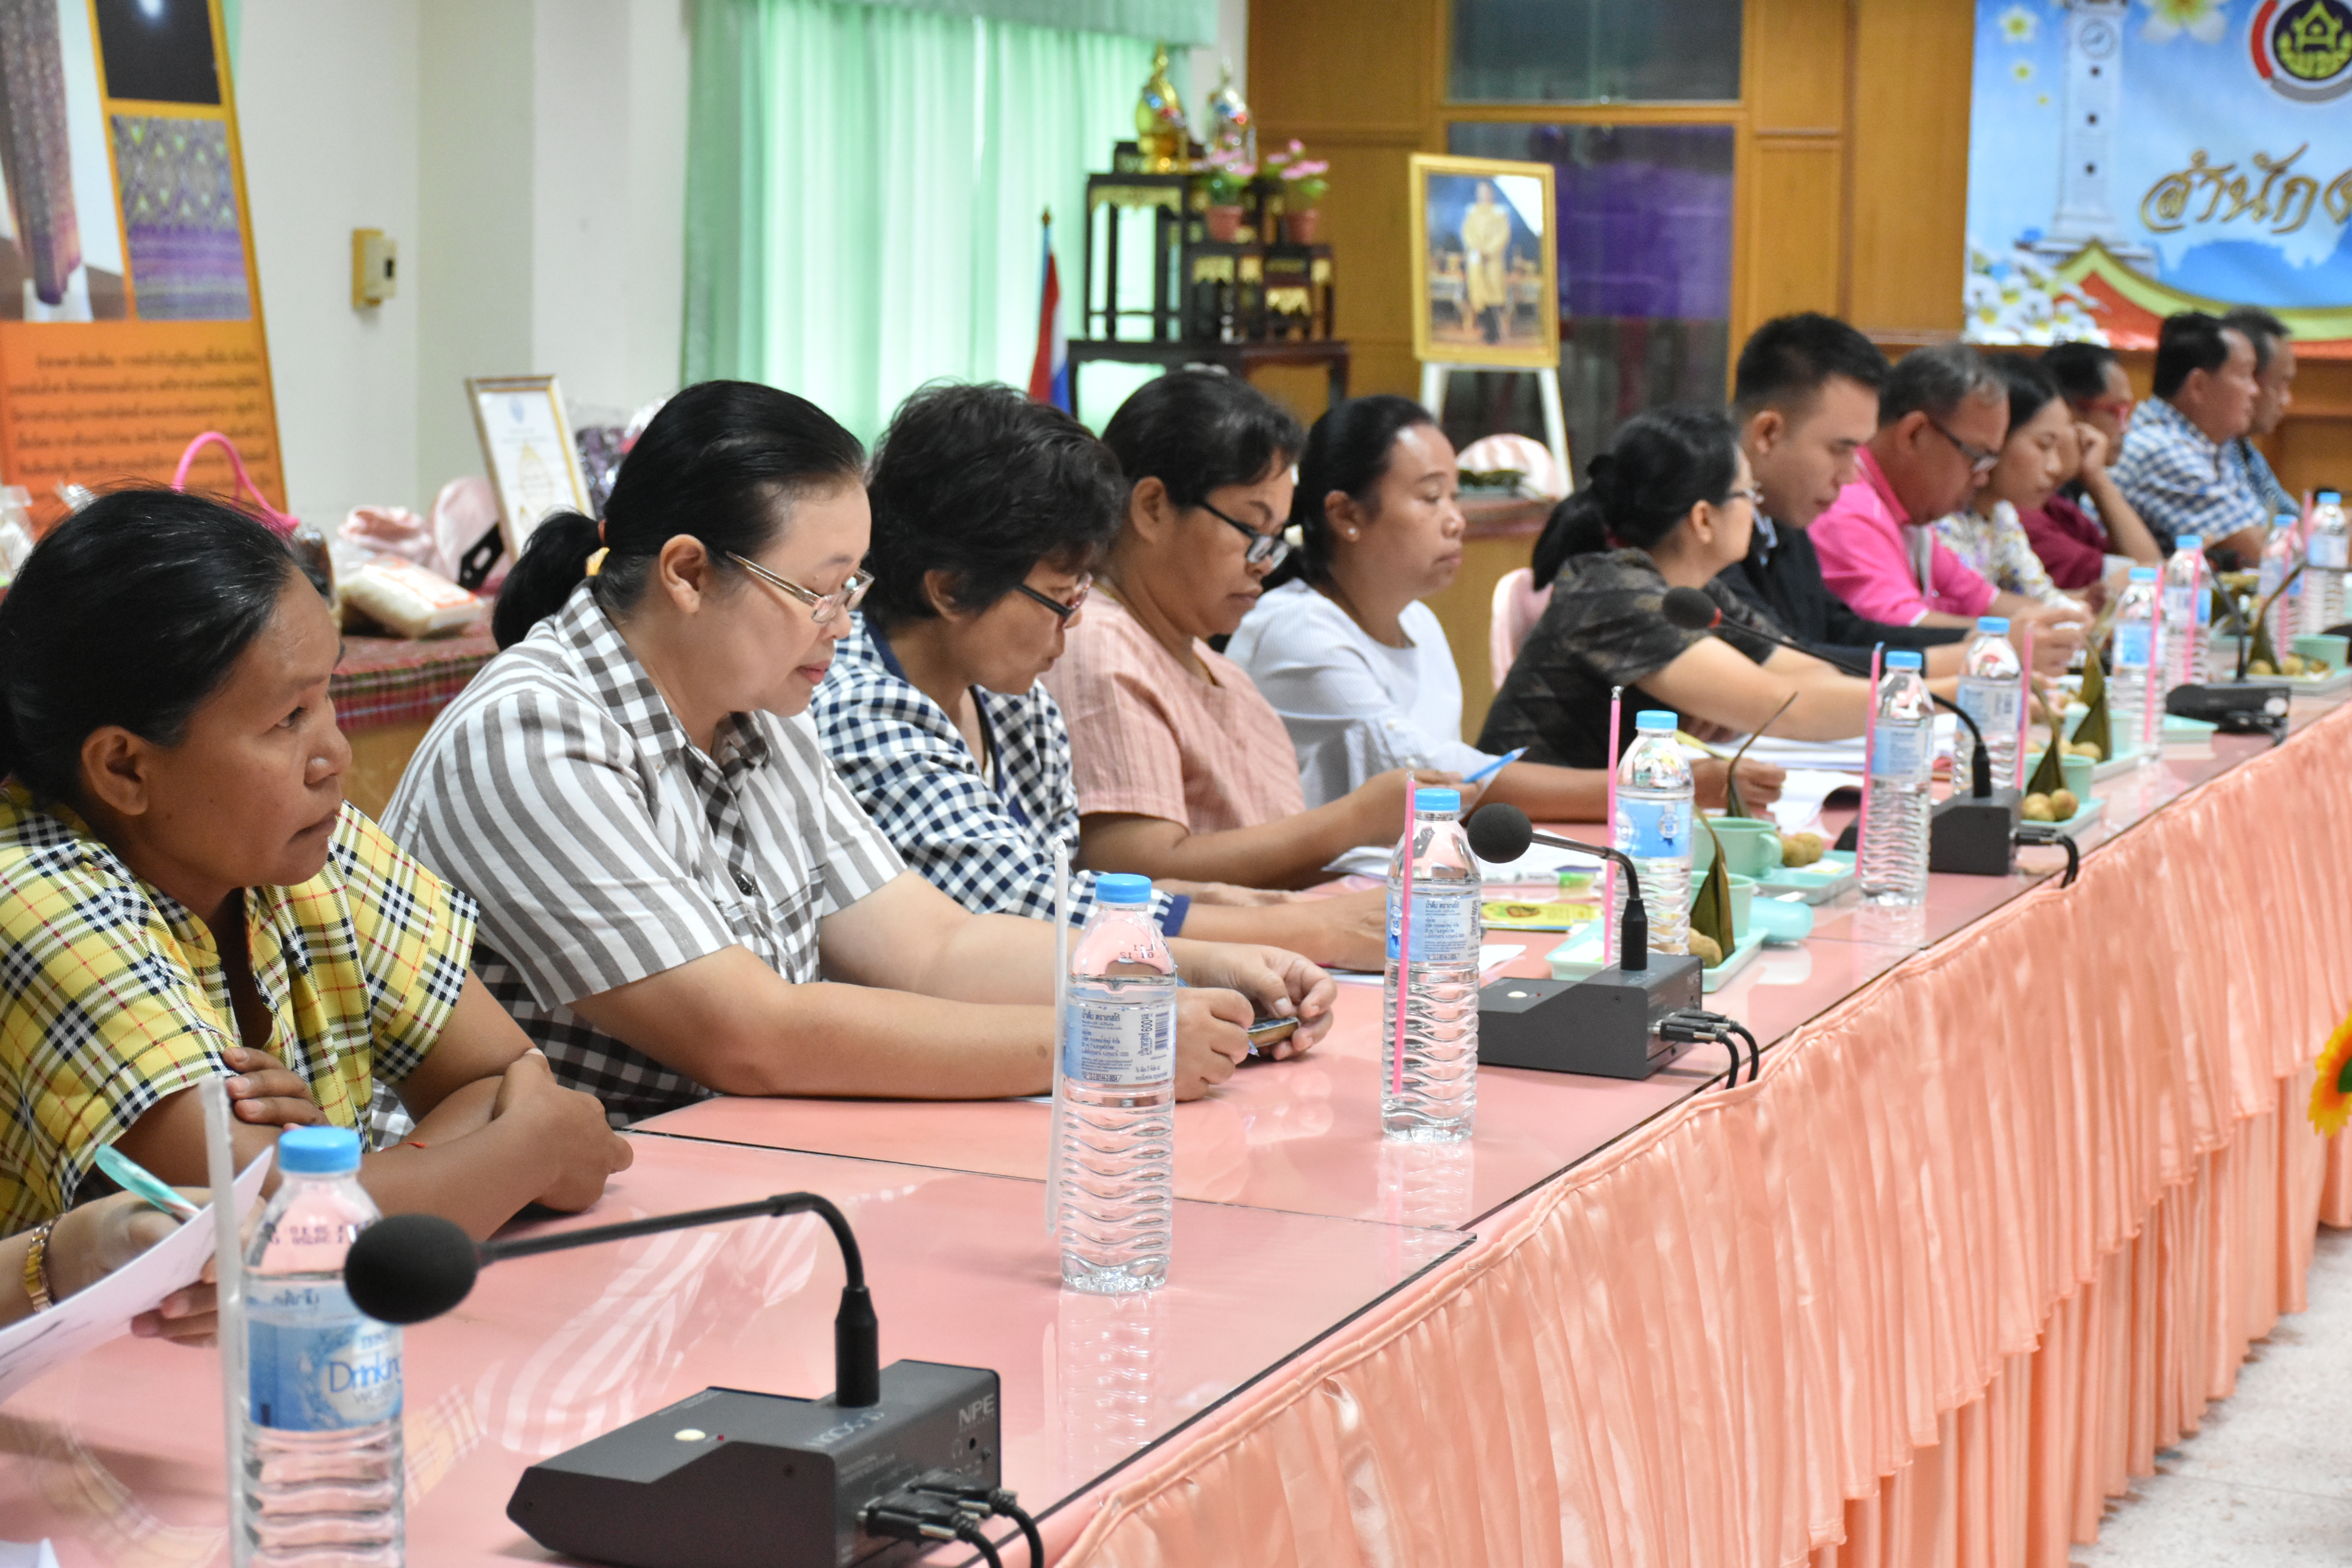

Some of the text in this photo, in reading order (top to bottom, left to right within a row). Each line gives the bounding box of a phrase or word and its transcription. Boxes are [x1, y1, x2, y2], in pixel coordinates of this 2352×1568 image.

[1082, 1009, 1120, 1022] น้ำดื่ม ตราเทสโก้
[1141, 1020, 1153, 1032] 600
[958, 1393, 995, 1427] NPE
